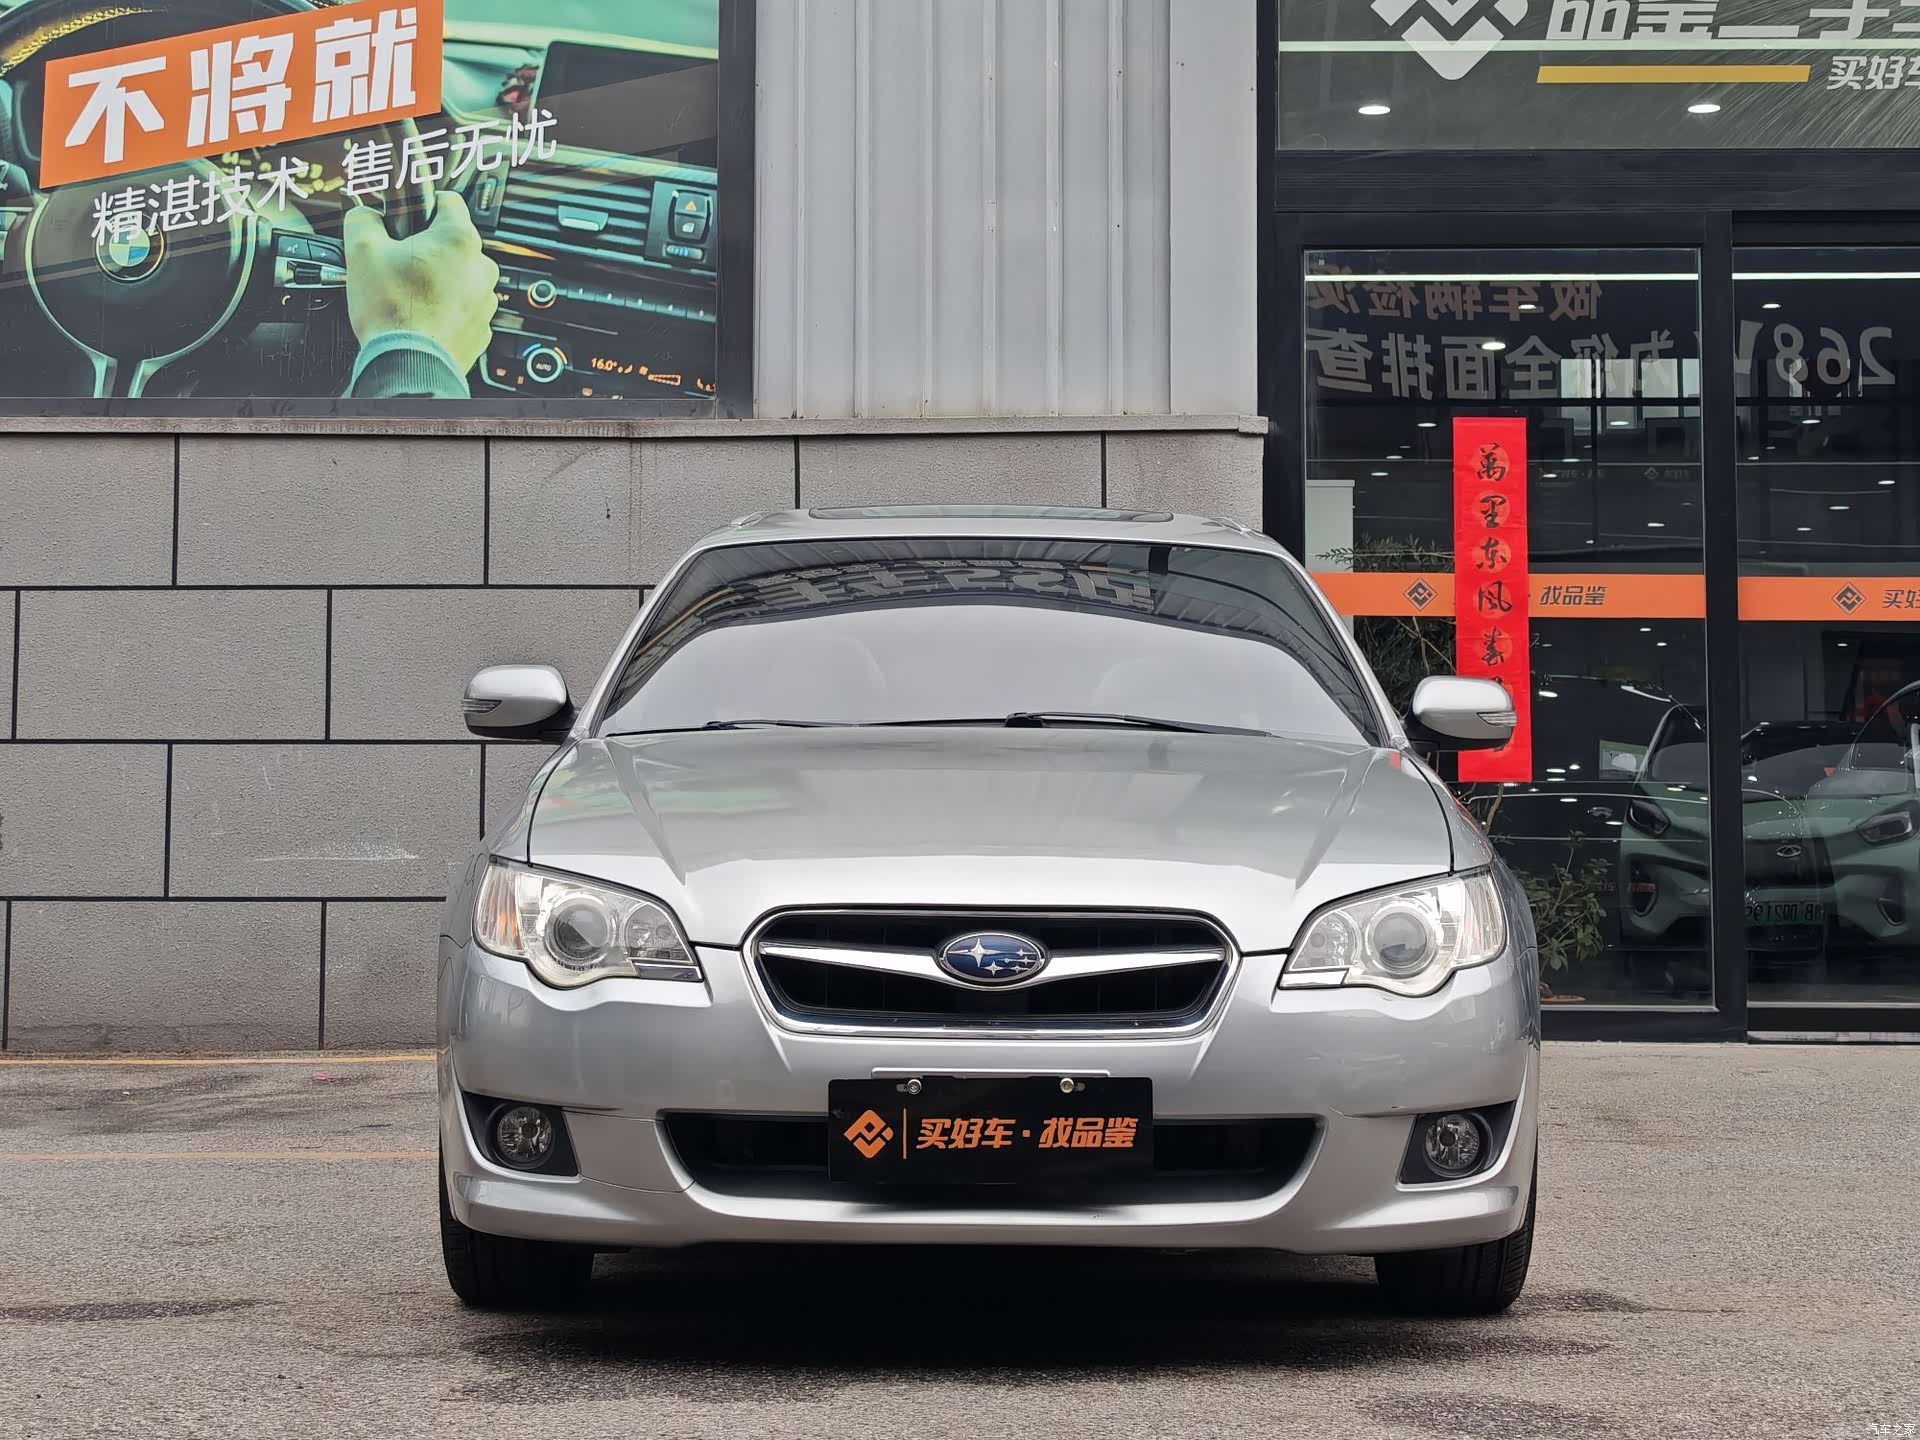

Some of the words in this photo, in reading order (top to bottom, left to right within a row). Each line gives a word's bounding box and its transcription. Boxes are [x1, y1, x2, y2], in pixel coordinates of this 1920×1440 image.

[65, 5, 418, 164] 不将就
[91, 157, 310, 247] 精湛技术
[341, 108, 558, 196] 售后无忧
